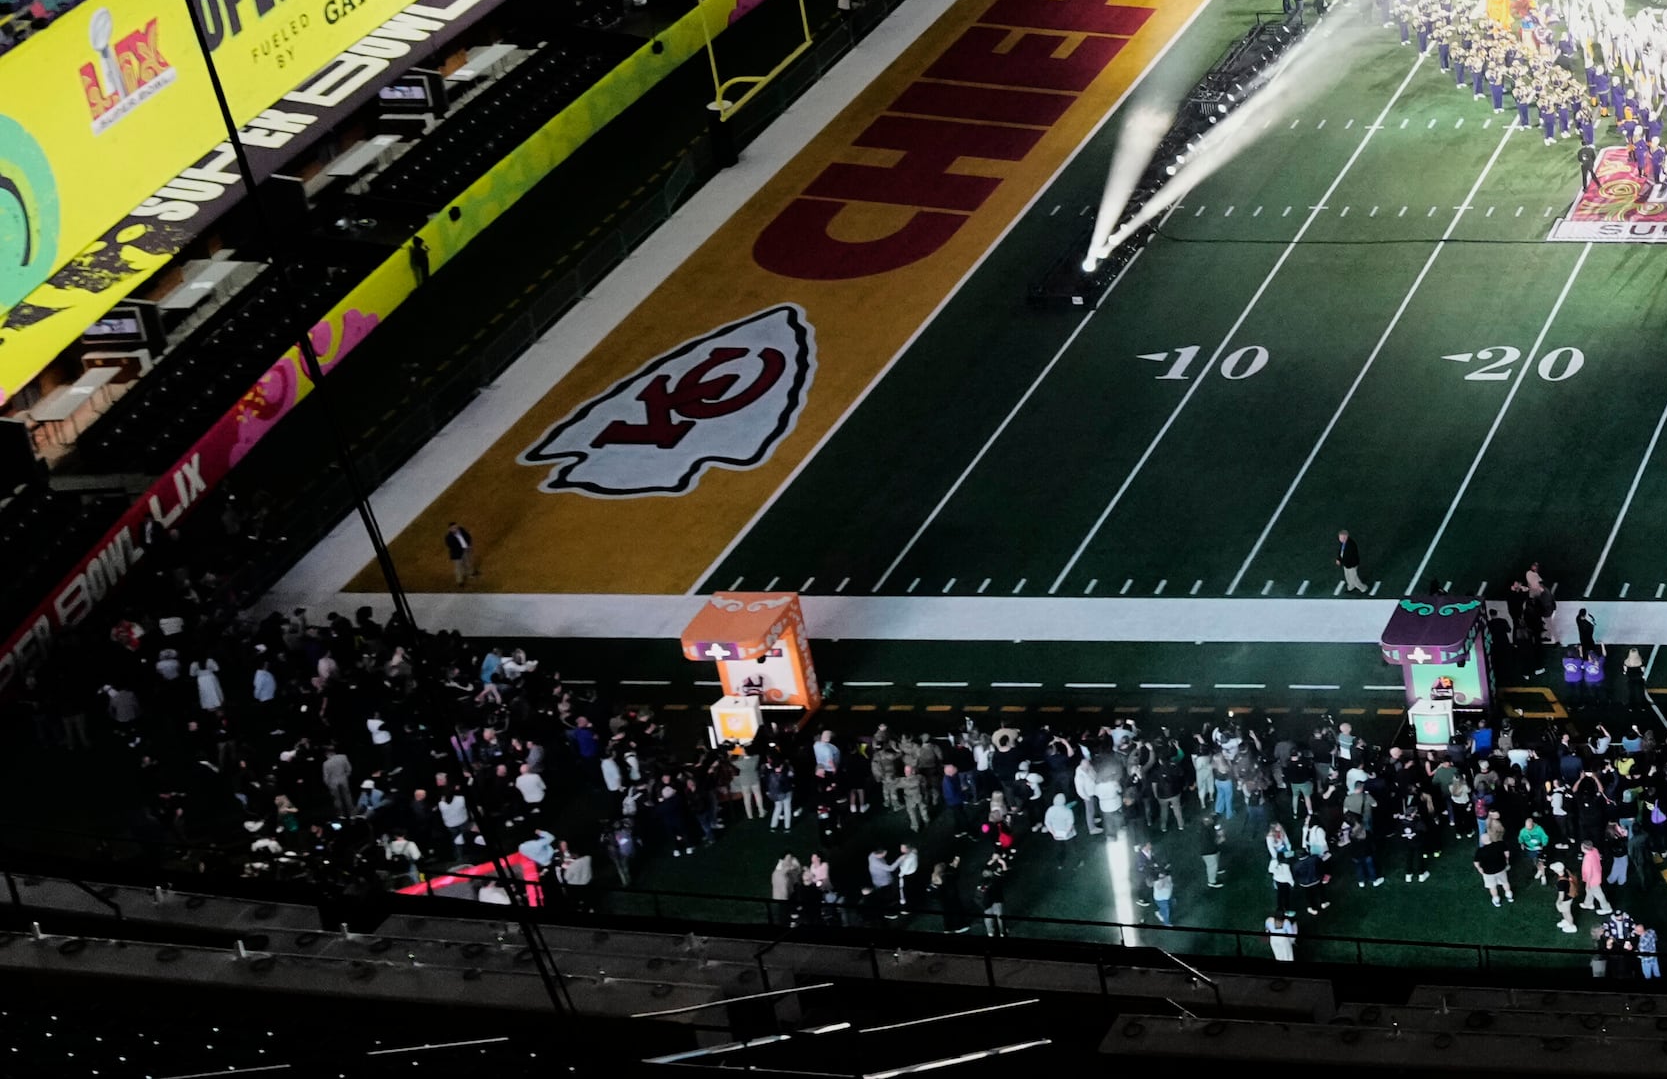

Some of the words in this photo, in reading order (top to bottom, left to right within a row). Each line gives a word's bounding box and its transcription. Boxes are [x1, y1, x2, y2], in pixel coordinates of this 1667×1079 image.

[252, 13, 310, 64] FUELED
[278, 50, 295, 69] BY
[1155, 346, 1269, 379] 10
[1464, 346, 1584, 381] 20
[53, 525, 145, 625] BOWL
[150, 452, 207, 528] LIX
